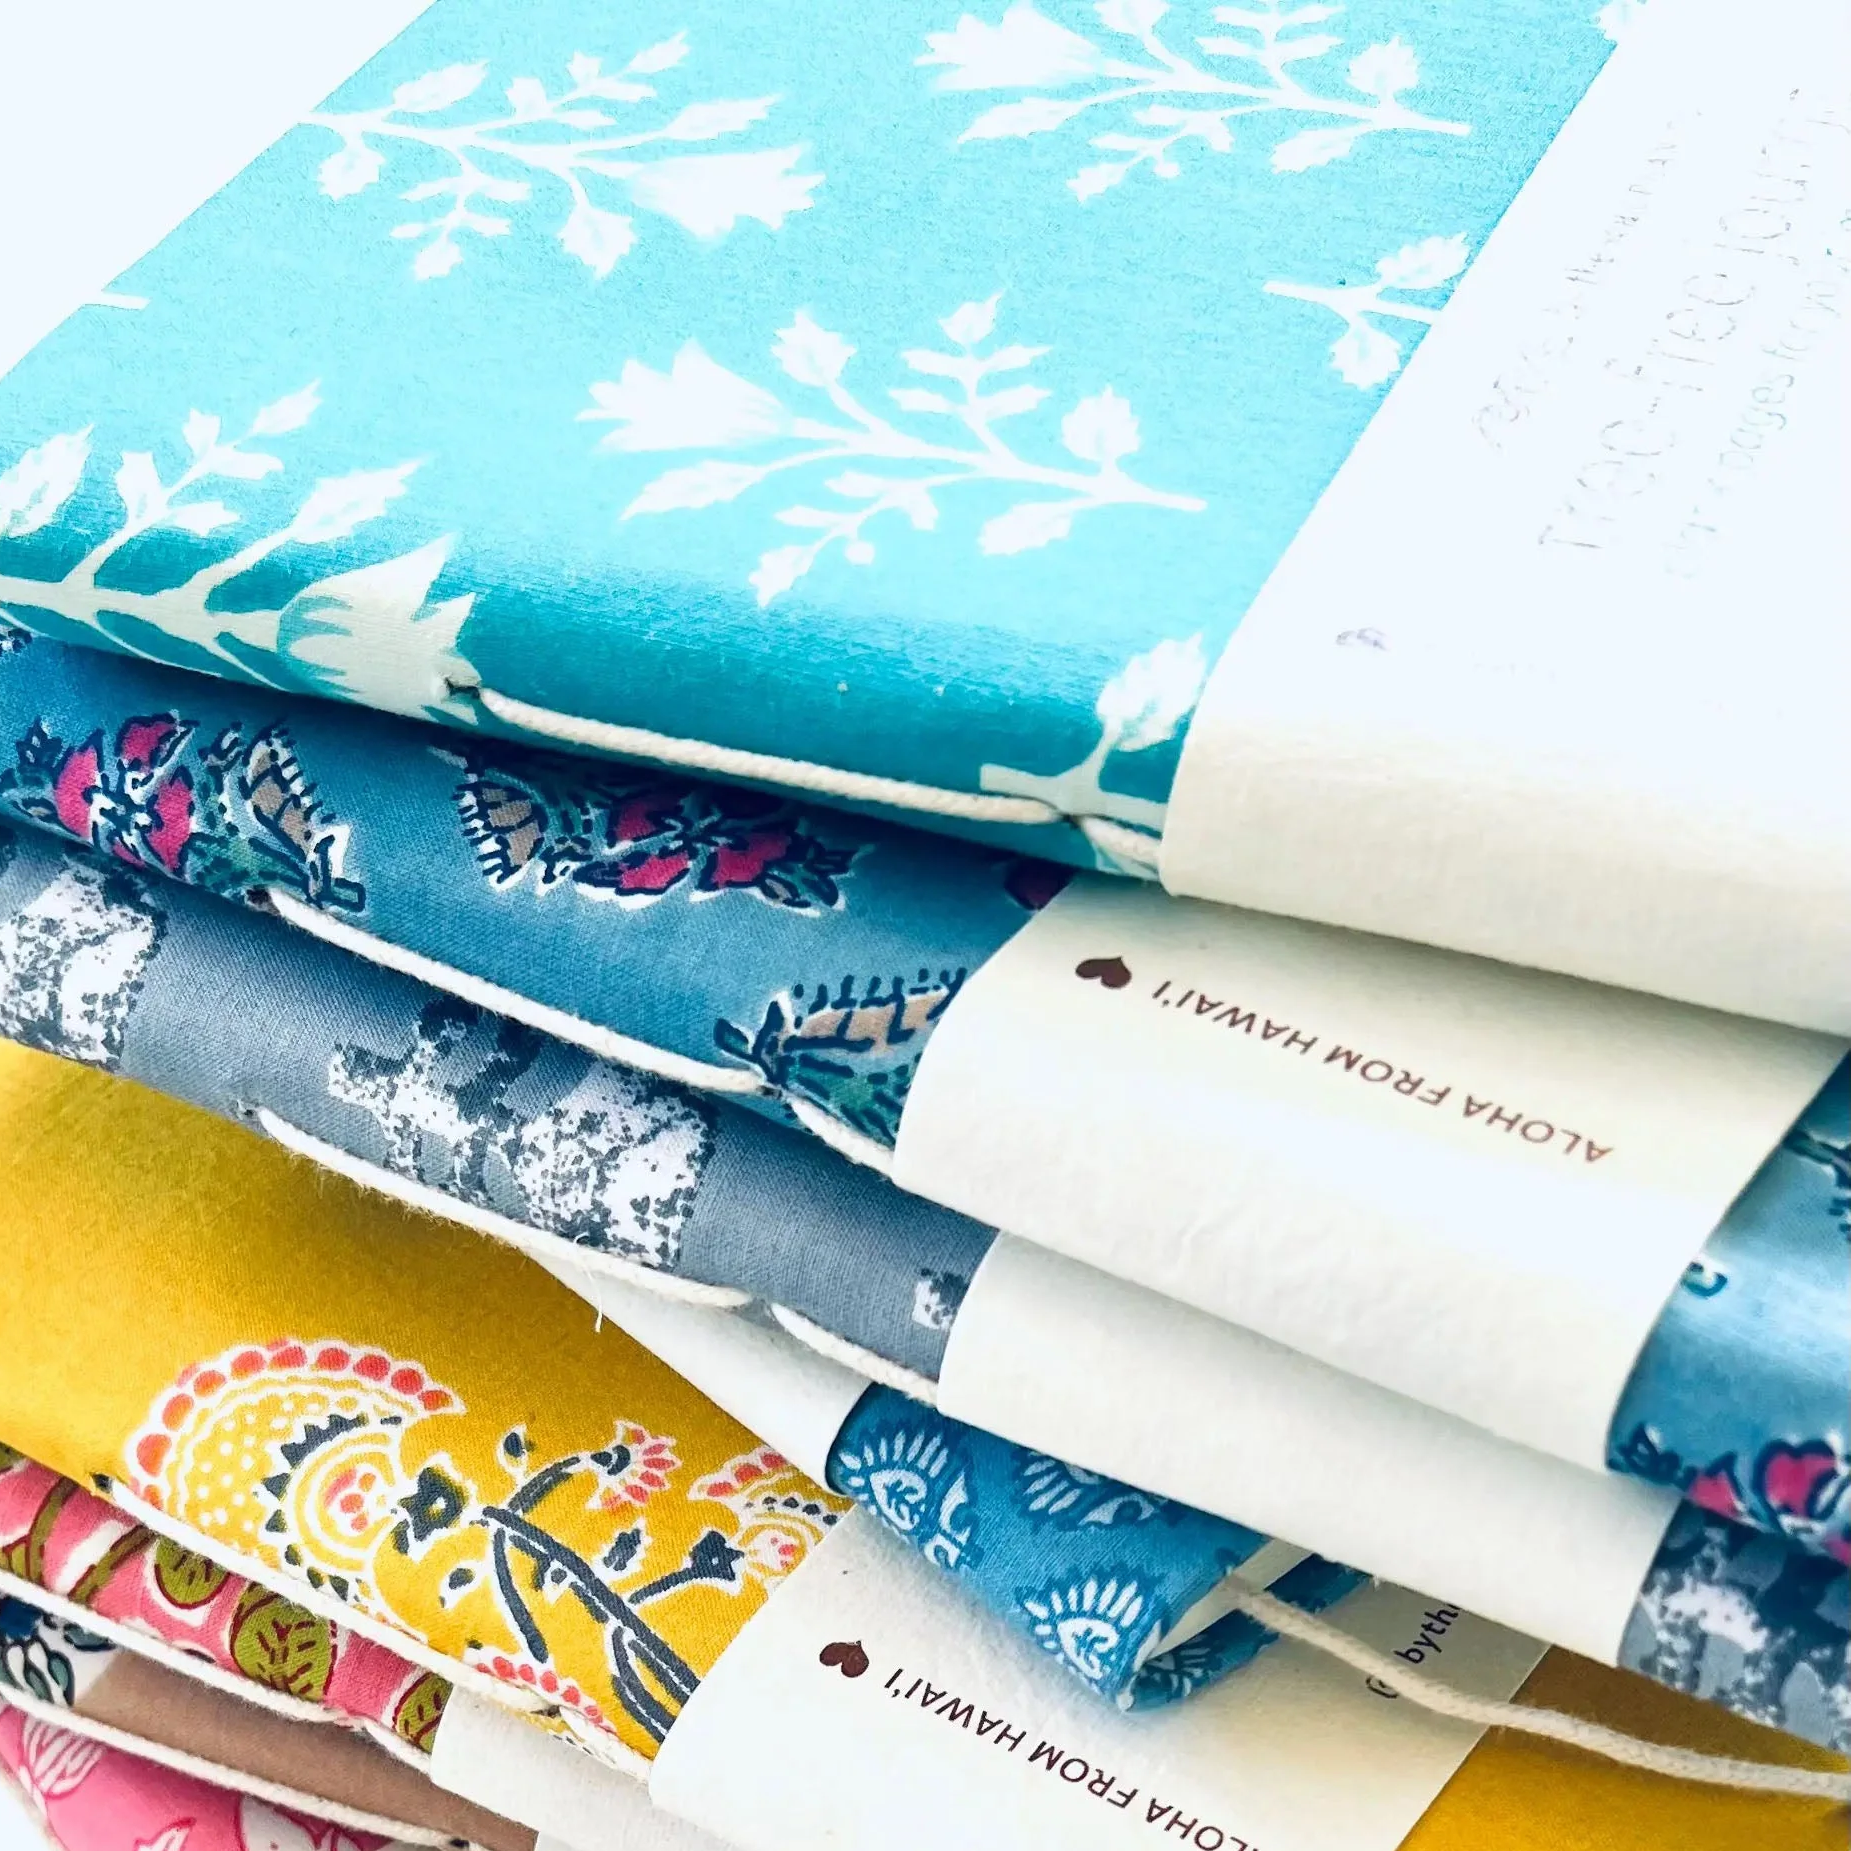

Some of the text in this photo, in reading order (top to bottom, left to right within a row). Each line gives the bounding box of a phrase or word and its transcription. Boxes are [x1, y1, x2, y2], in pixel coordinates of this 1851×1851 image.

[1323, 1045, 1451, 1107] FROM
[1463, 1095, 1613, 1163] ALOHA
[1027, 1740, 1138, 1809] FROM
